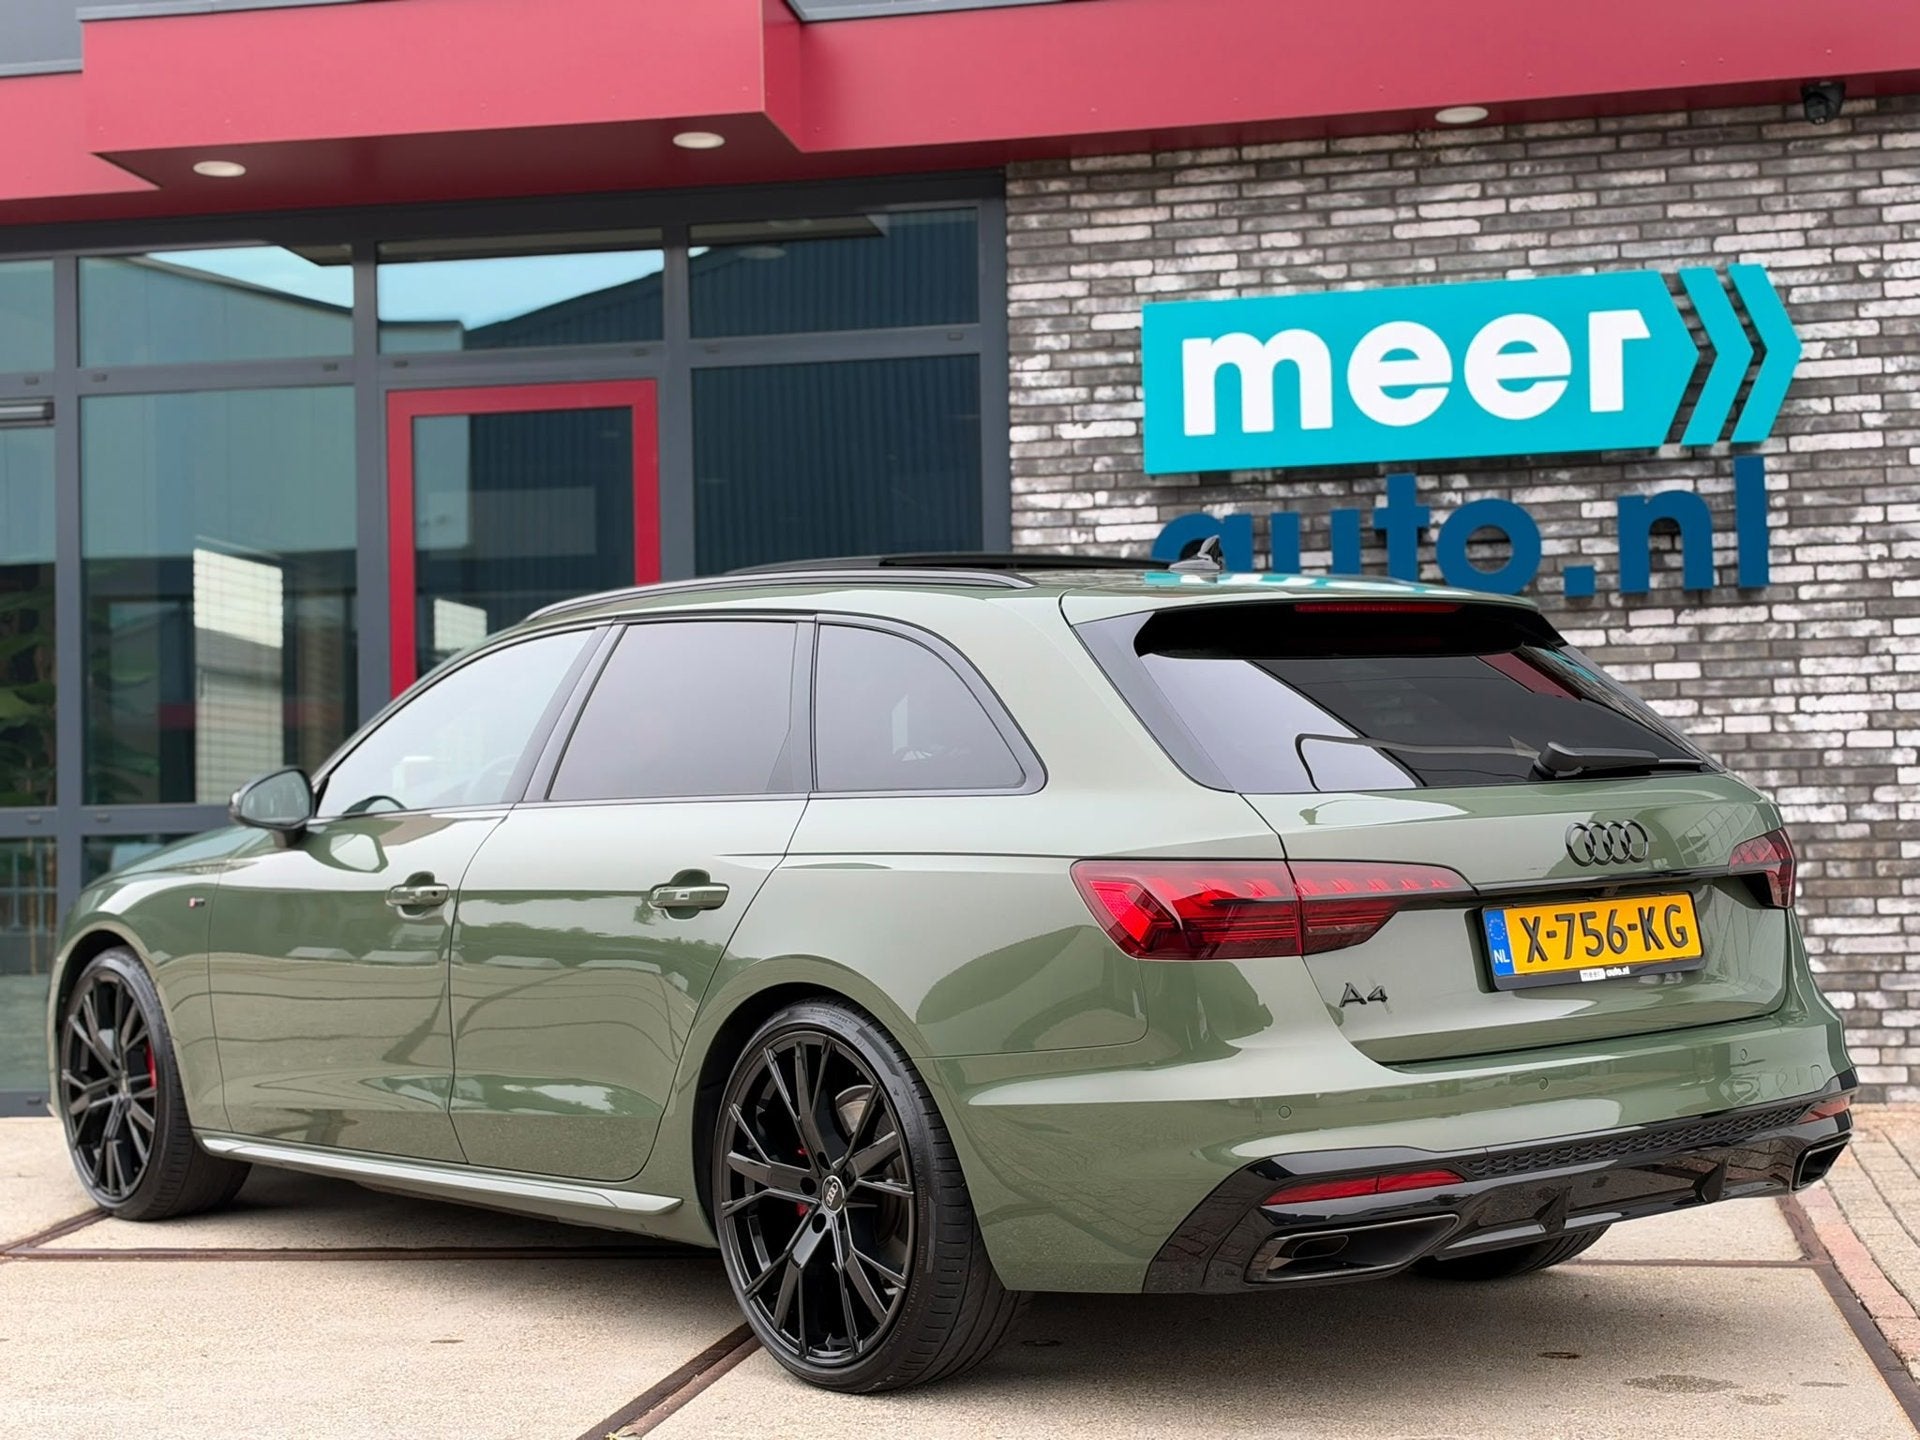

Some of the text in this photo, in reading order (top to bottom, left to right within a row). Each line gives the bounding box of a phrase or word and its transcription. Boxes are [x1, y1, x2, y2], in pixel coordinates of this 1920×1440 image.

[1182, 309, 1651, 436] meer
[1151, 455, 1770, 597] auto.nl
[1493, 948, 1511, 964] NL
[1519, 903, 1689, 963] X-756-KG
[1339, 982, 1389, 1008] A4
